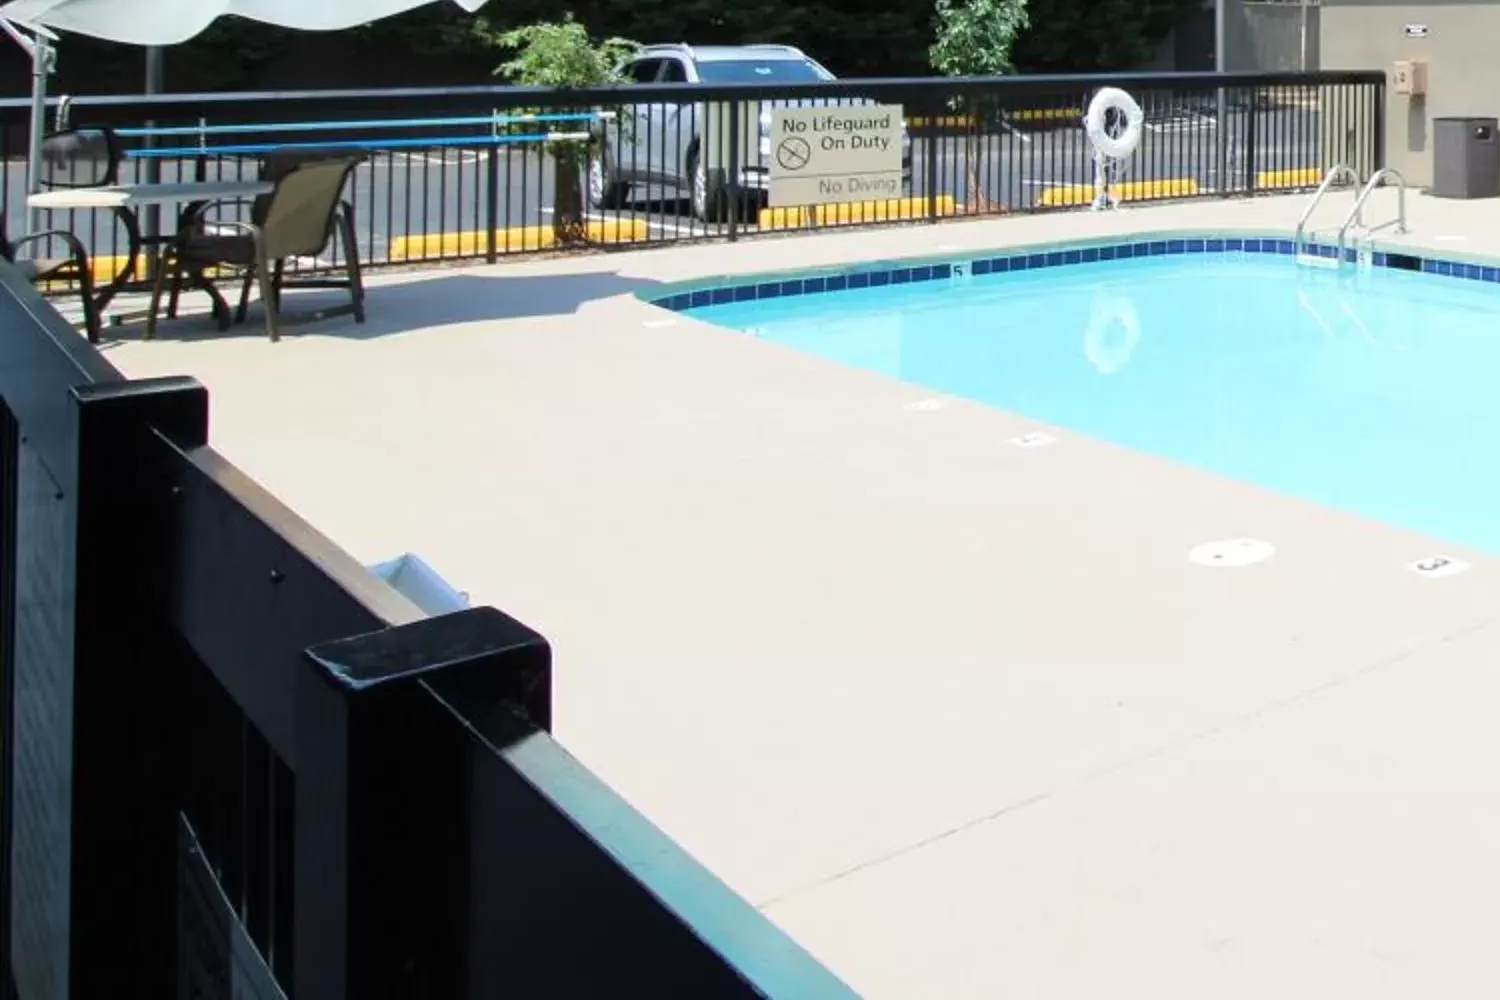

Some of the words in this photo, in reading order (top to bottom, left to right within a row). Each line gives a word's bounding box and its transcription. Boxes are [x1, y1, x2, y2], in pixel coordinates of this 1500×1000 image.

[783, 118, 807, 133] No
[813, 114, 890, 134] Lifeguard
[821, 136, 845, 151] On
[851, 135, 890, 151] Duty
[819, 179, 843, 194] No
[848, 177, 897, 193] Diving
